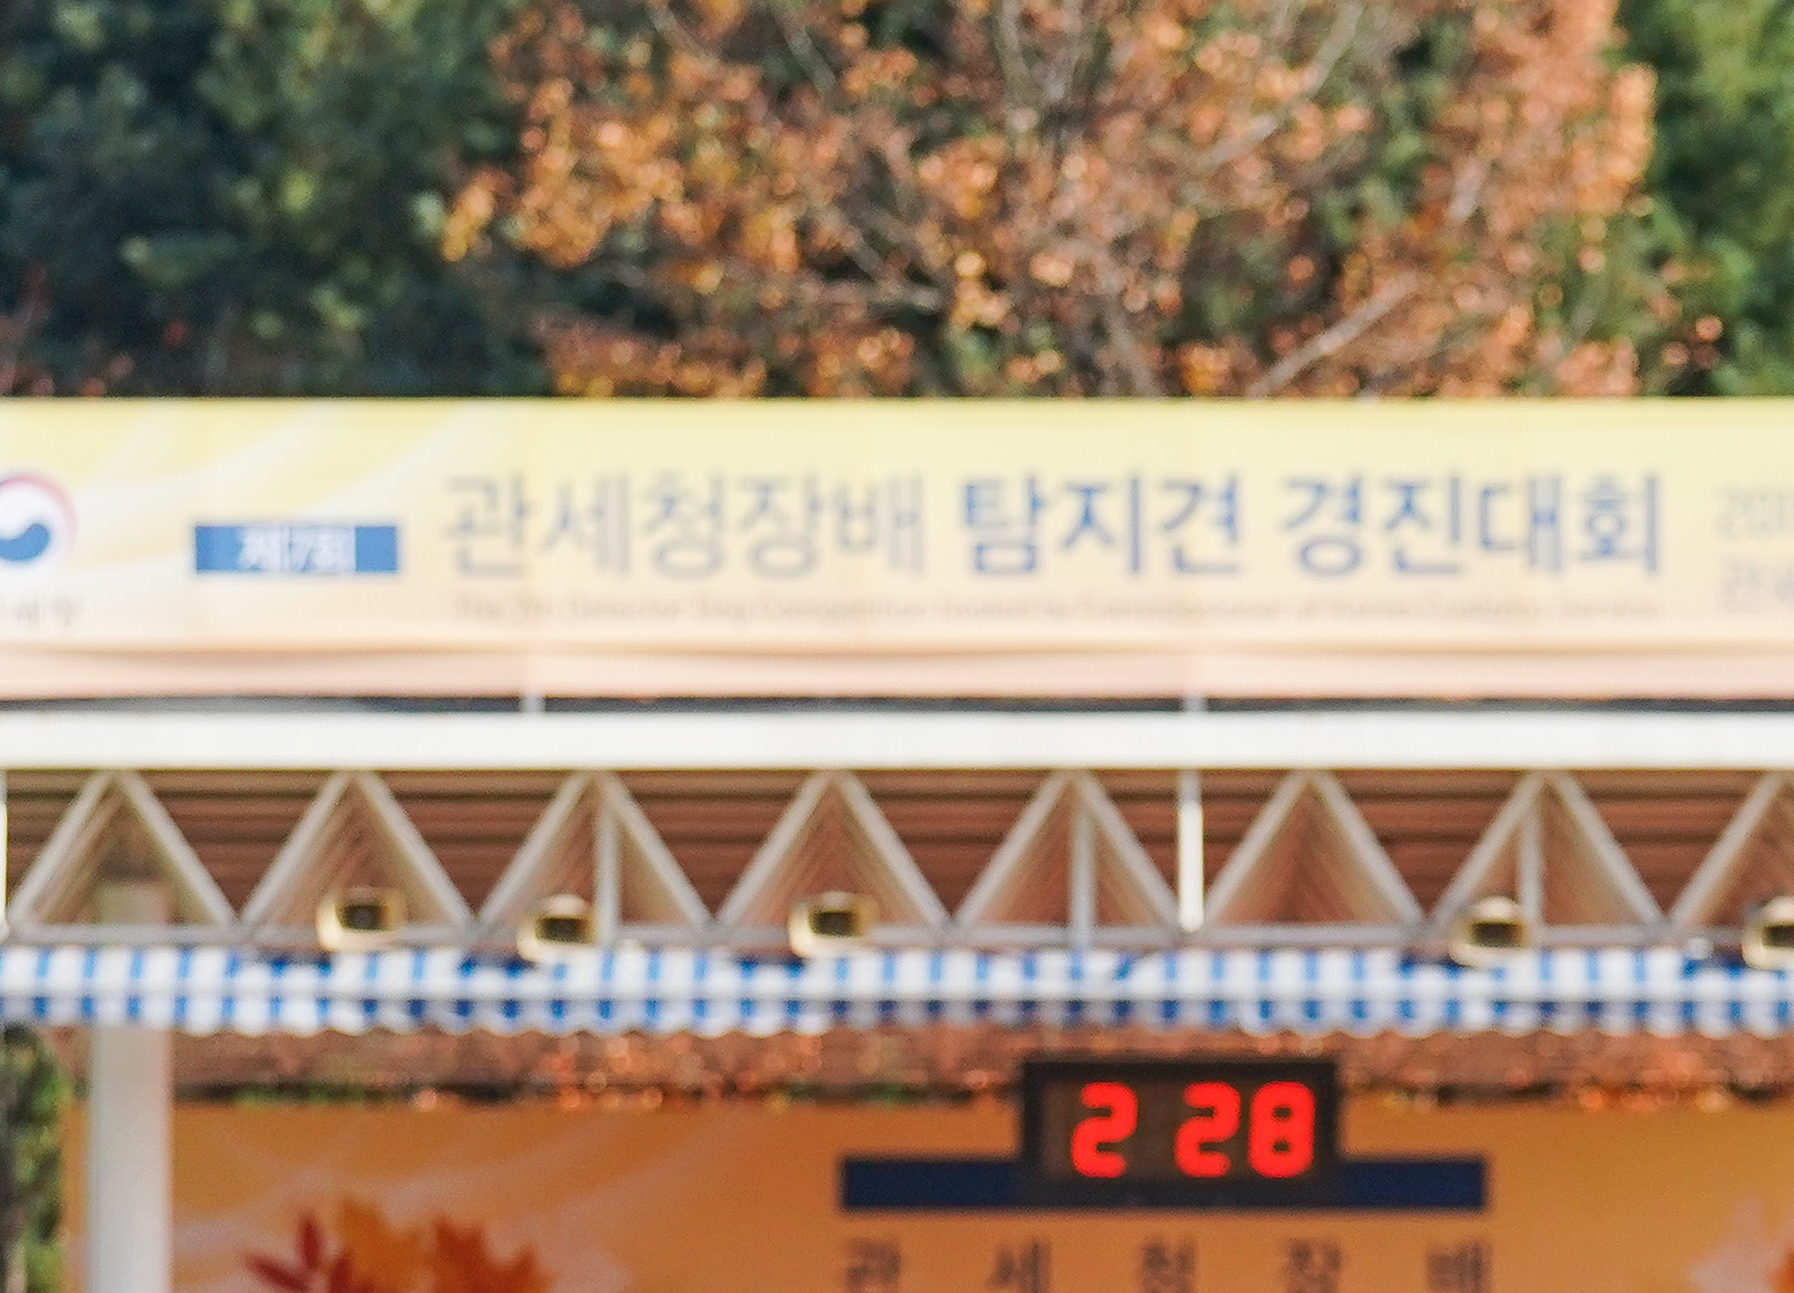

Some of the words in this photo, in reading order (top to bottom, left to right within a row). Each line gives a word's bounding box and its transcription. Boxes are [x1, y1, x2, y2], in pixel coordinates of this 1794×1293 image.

[443, 472, 927, 581] 관세청장배
[960, 472, 1242, 578] 탐지견
[1280, 472, 1662, 580] 경진대회
[1070, 1082, 1139, 1178] 2
[1175, 1082, 1317, 1178] 28
